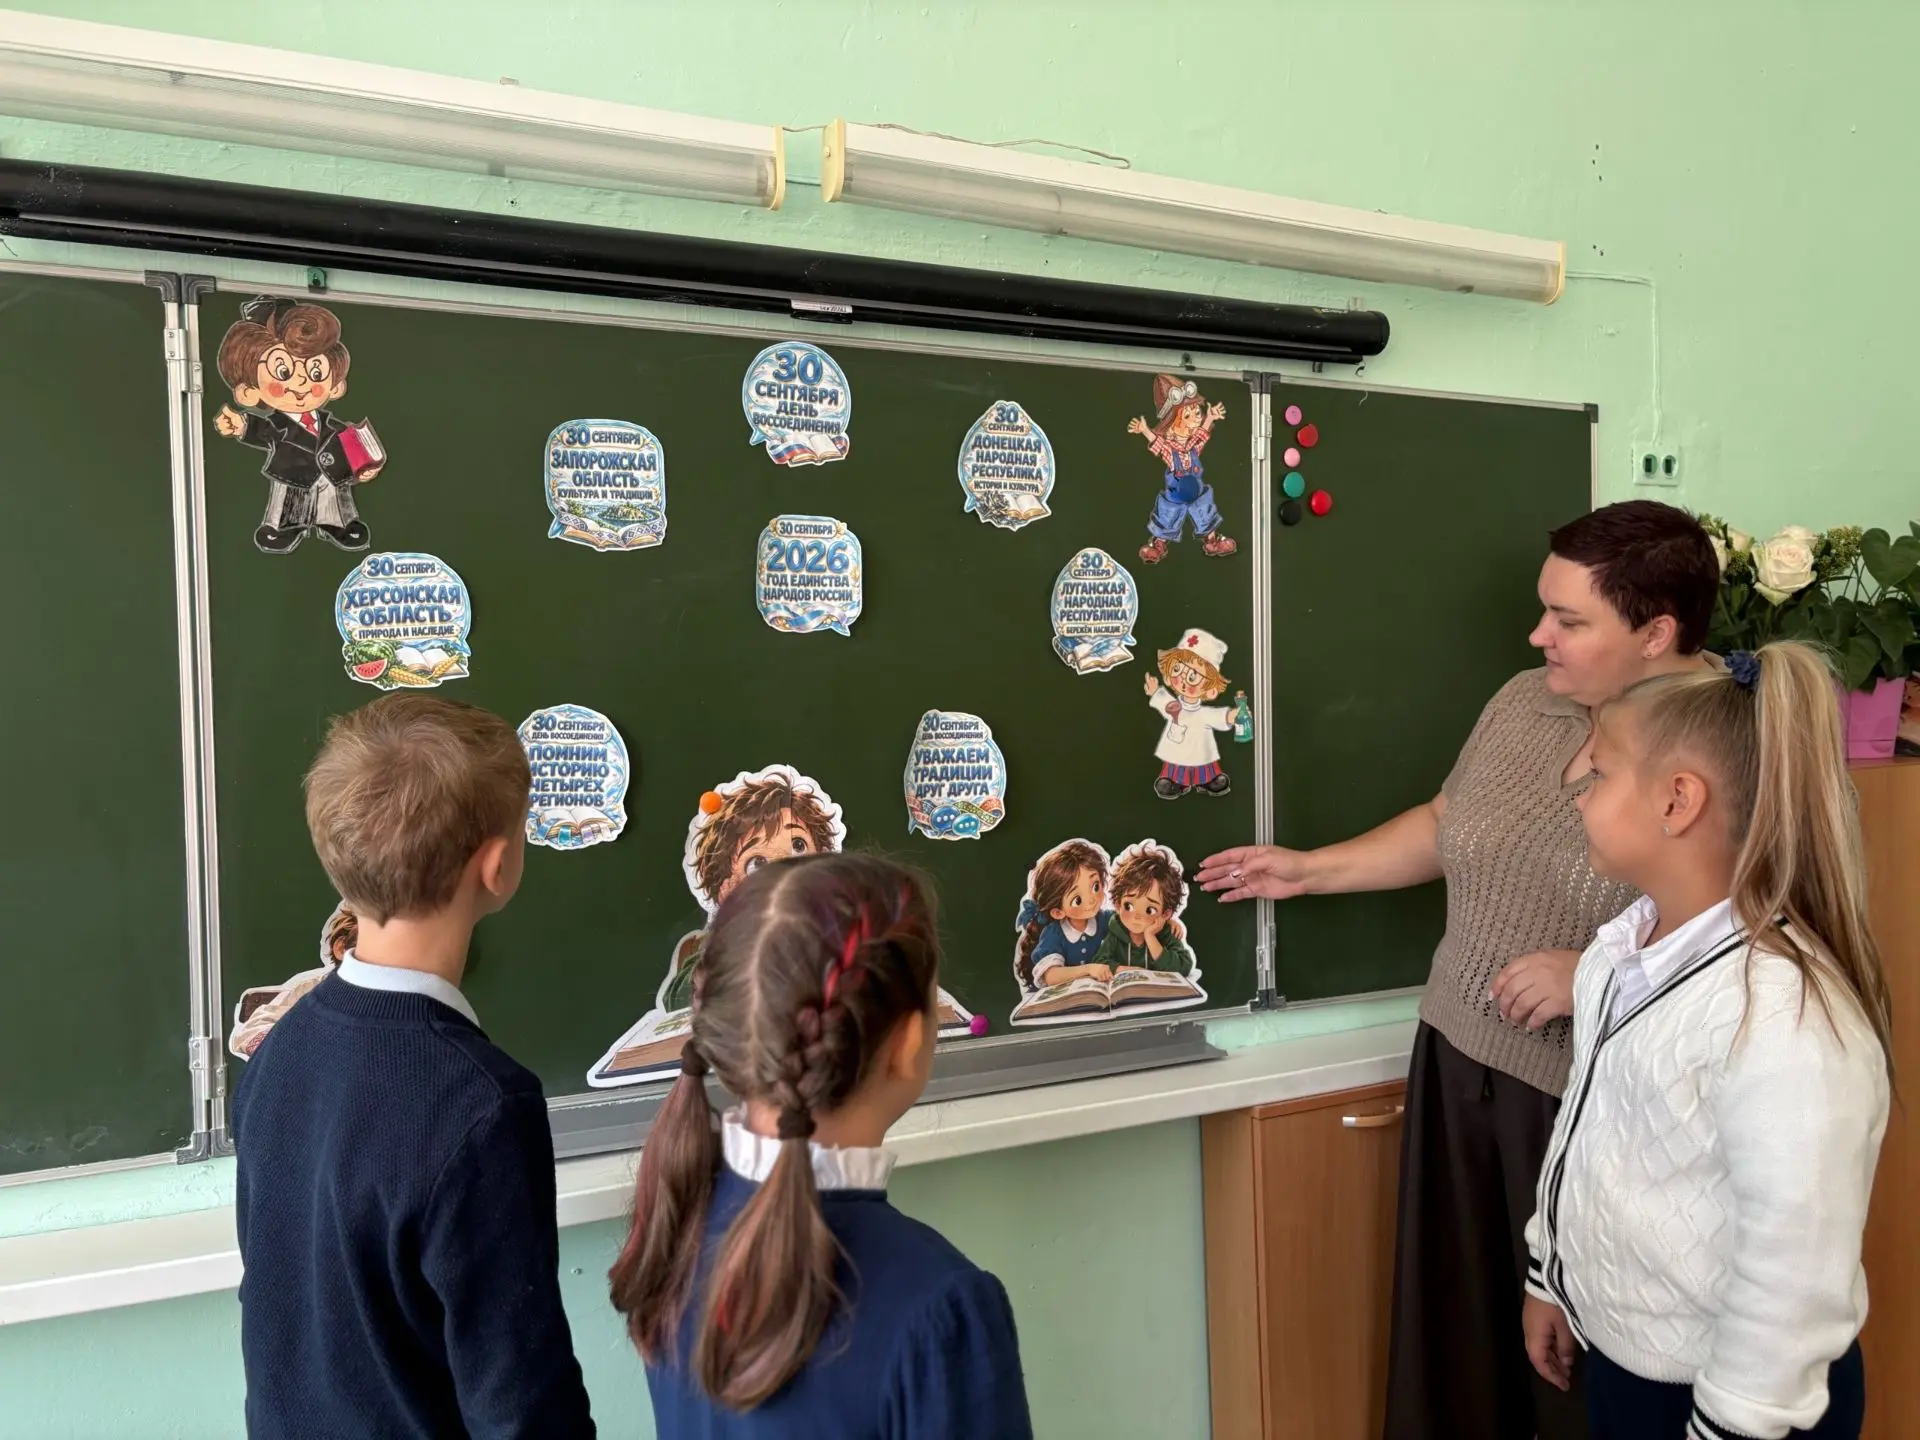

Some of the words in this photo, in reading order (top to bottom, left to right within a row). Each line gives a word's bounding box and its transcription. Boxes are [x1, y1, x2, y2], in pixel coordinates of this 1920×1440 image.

[773, 349, 823, 385] 30
[754, 380, 840, 406] СЕНТЯБРЯ
[776, 401, 819, 418] ДЕНЬ
[995, 405, 1020, 423] 30
[752, 412, 841, 434] ВОССОЕДИНЕНИЯ
[988, 423, 1025, 433] СЕНТЯБРЯ
[565, 426, 590, 446] 30
[591, 430, 641, 445] СЕНТЯБРЯ
[971, 434, 1042, 453] ДОНЕЦКАЯ
[550, 448, 657, 471] ЗАПОРОЖСКАЯ
[975, 451, 1038, 467] НАРОДНАЯ
[571, 470, 640, 488] ОБЛАСТЬ
[971, 464, 1044, 481] РЕСПУБЛИКА
[557, 488, 600, 499] КУЛЬТУРА
[601, 489, 608, 498] И
[610, 490, 653, 501] ТРАДИЦИИ
[973, 481, 1002, 490] ИСТОРИЯ
[1009, 482, 1040, 494] КУЛЬТУРА
[779, 521, 793, 535] 30
[794, 523, 833, 535] СЕНТЯБРЯ
[767, 539, 850, 574] 2026
[1080, 552, 1103, 569] 30
[366, 557, 394, 577] 30
[394, 562, 437, 574] СЕНТЯБРЯ
[1073, 568, 1111, 577] СЕНТЯБРЯ
[766, 573, 788, 586] ГОД
[790, 574, 850, 588] ЕДИНСТВА
[1061, 582, 1126, 596] ЛУГАНСКАЯ
[343, 584, 461, 609] ХЕРСОНСКАЯ
[763, 586, 811, 601] НАРОДОВ
[812, 588, 853, 602] РОССИИ
[1064, 596, 1123, 608] НАРОДНАЯ
[358, 604, 453, 626] ОБЛАСТЬ
[1060, 609, 1128, 622] РЕСПУБЛИКА
[358, 628, 402, 639] ПРИРОДА
[402, 628, 410, 637] И
[411, 625, 455, 637] НАСЛЕДИЕ
[532, 713, 557, 731] 30
[557, 720, 605, 732] СЕНТЯБРЯ
[923, 713, 940, 731] 30
[940, 721, 979, 731] СЕНТЯБРЯ
[532, 731, 549, 740] ДЕНЬ
[550, 732, 604, 741] ВОССОЕДИНЕНИЯ
[528, 745, 608, 762] ПОМНИМ
[914, 747, 990, 766] УВАЖАЕМ
[913, 765, 993, 783] ТРАДИЦИИ
[916, 782, 945, 798] ДРУГ
[947, 781, 990, 797] ДРУГА
[529, 792, 605, 807] РЕГИОНОВ
